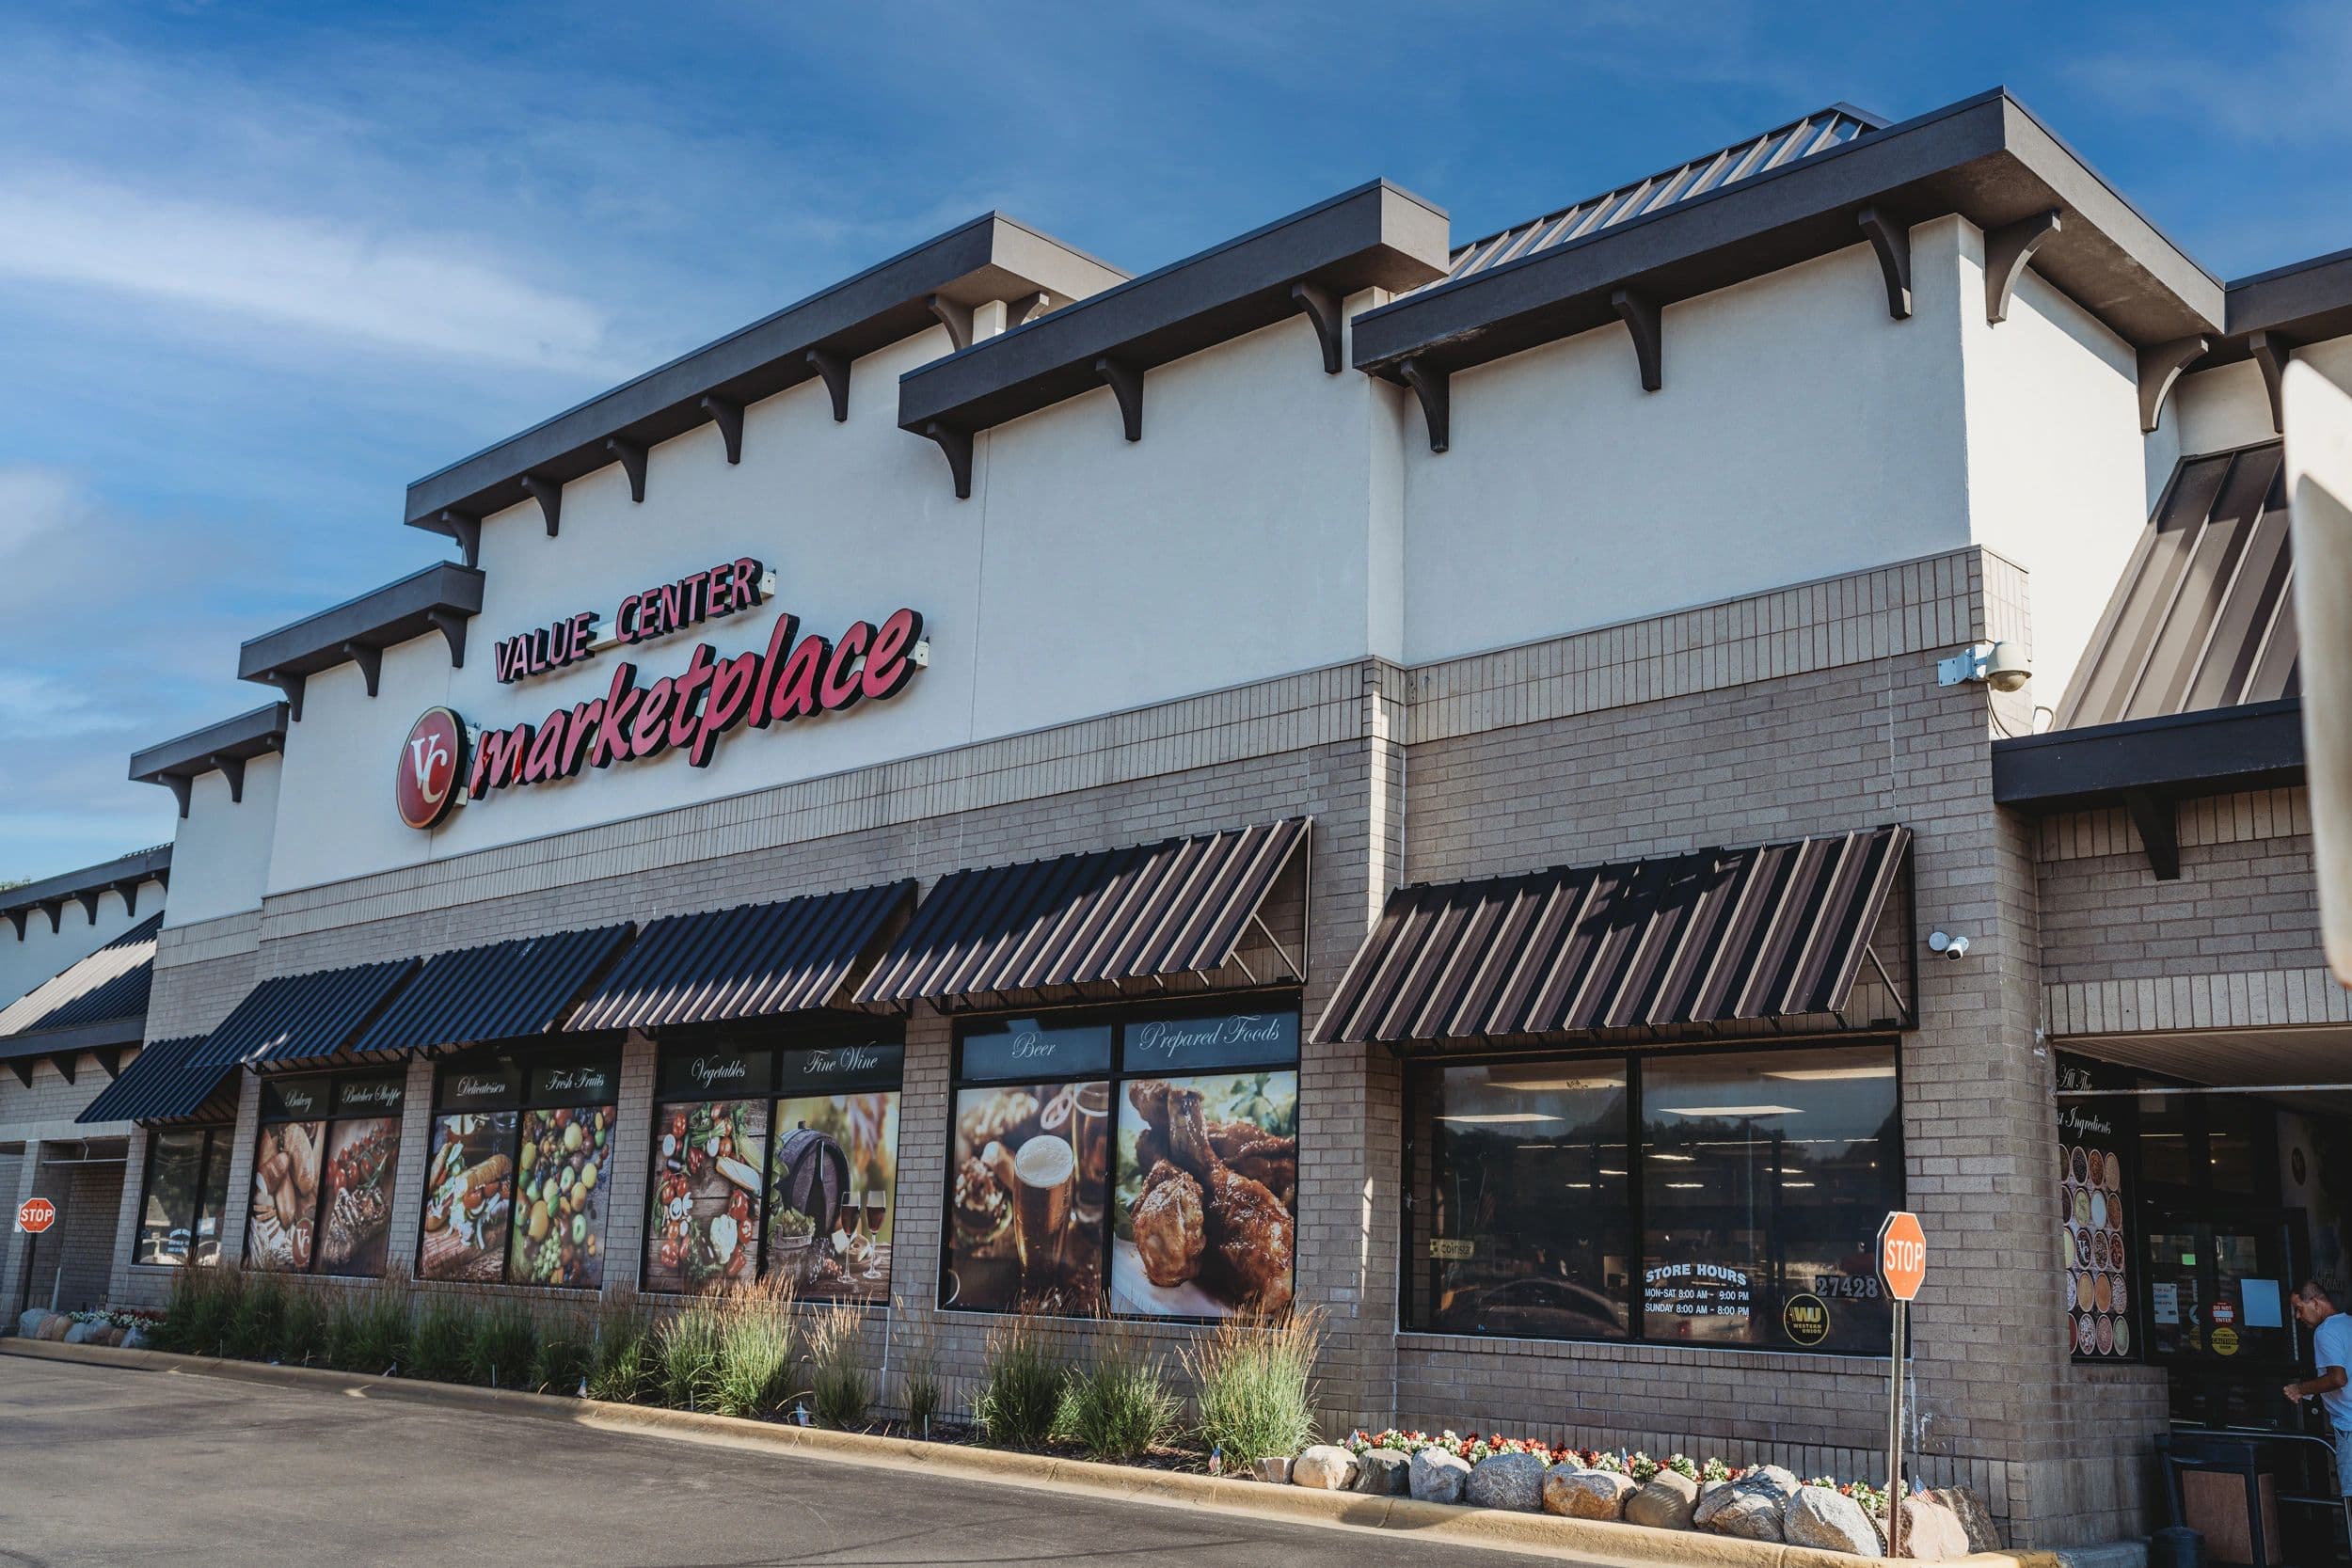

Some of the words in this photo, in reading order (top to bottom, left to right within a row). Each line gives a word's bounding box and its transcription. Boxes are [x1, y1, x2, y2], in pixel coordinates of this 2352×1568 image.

[495, 611, 599, 684] VALUE
[616, 557, 763, 644] CENTER
[469, 608, 924, 800] marketplace
[410, 733, 448, 804] VC
[1011, 1031, 1057, 1058] Beer
[1139, 1021, 1223, 1057] Prepared
[1223, 1014, 1279, 1044] Foods
[803, 1049, 836, 1073] Fine
[840, 1040, 879, 1071] Wine
[545, 1069, 574, 1091] Fresh
[574, 1067, 605, 1088] Fruits
[691, 1054, 746, 1089] Vegetables
[342, 1084, 373, 1103] Butcher
[374, 1084, 402, 1106] Shoppe
[456, 1075, 506, 1097] Delicatessen
[285, 1090, 313, 1113] Bakery
[2065, 1105, 2112, 1138] Ingredients
[20, 1209, 53, 1222] STOP
[1886, 1239, 1924, 1273] STOP
[1645, 1263, 1692, 1283] STORE
[1696, 1263, 1747, 1286] HOURS
[1816, 1276, 1879, 1297] 27428
[1645, 1288, 1677, 1299] MON-SAT
[1678, 1289, 1694, 1299] 8:00
[1696, 1290, 1708, 1299] AM
[1719, 1291, 1737, 1300] 9:00
[1738, 1291, 1749, 1301] PM
[1645, 1303, 1674, 1313] SUNDAY
[1676, 1304, 1693, 1314] 8:00
[1695, 1305, 1708, 1314] AM
[1717, 1306, 1735, 1315] 8:00
[1737, 1307, 1749, 1316] PM
[1794, 1307, 1820, 1322] WU
